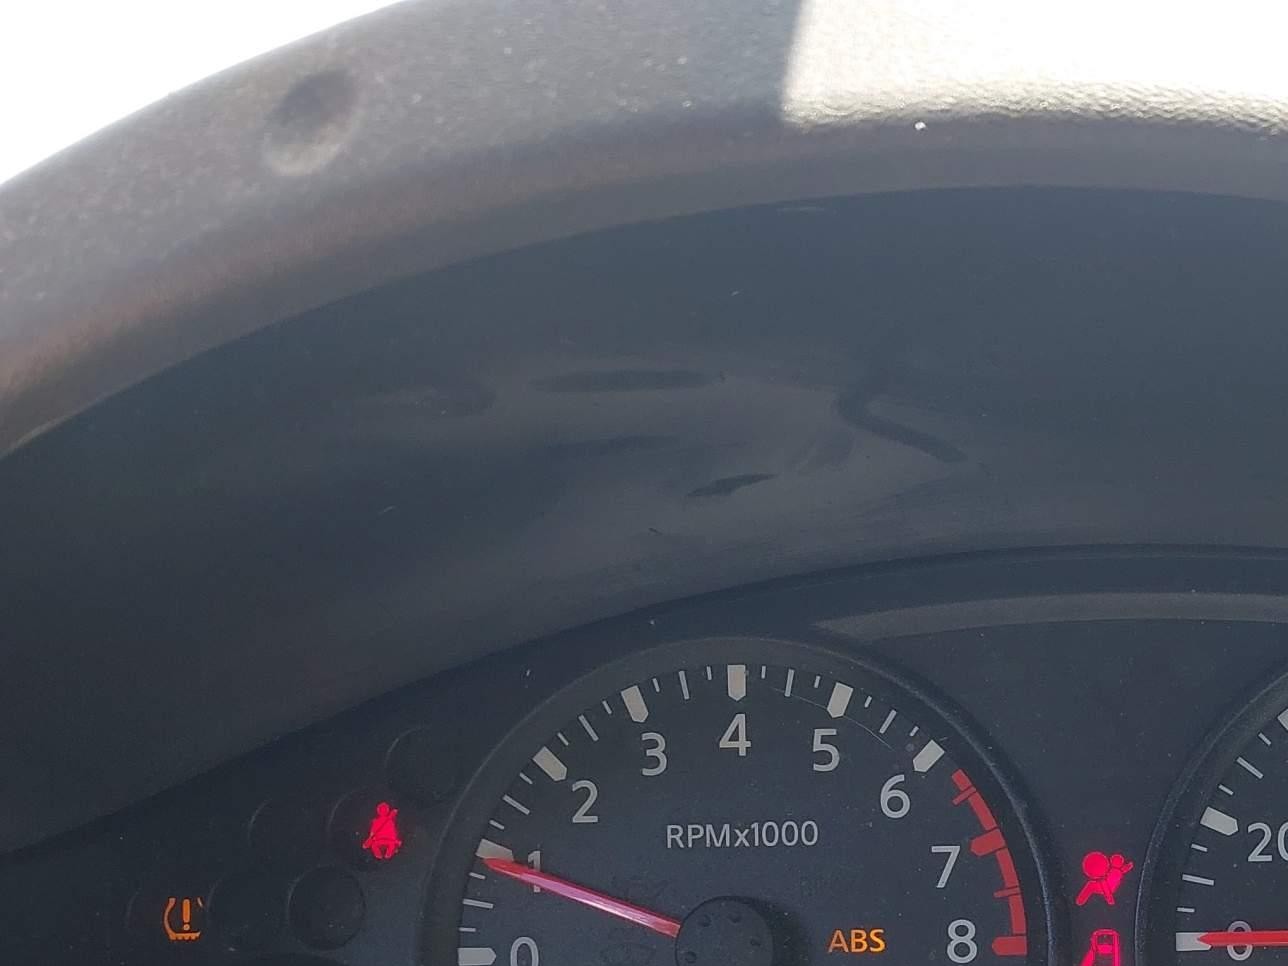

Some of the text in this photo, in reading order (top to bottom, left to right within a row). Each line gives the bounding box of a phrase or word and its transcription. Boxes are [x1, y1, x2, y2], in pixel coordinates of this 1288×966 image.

[641, 732, 668, 776] 3
[719, 713, 752, 757] 4
[812, 728, 840, 772] 5
[572, 780, 599, 823] 2
[880, 774, 911, 819] 6
[666, 820, 819, 849] RPMx1000
[931, 845, 961, 888] 7
[828, 929, 886, 953] ABS
[946, 919, 978, 964] 8
[1226, 920, 1253, 961] 0
